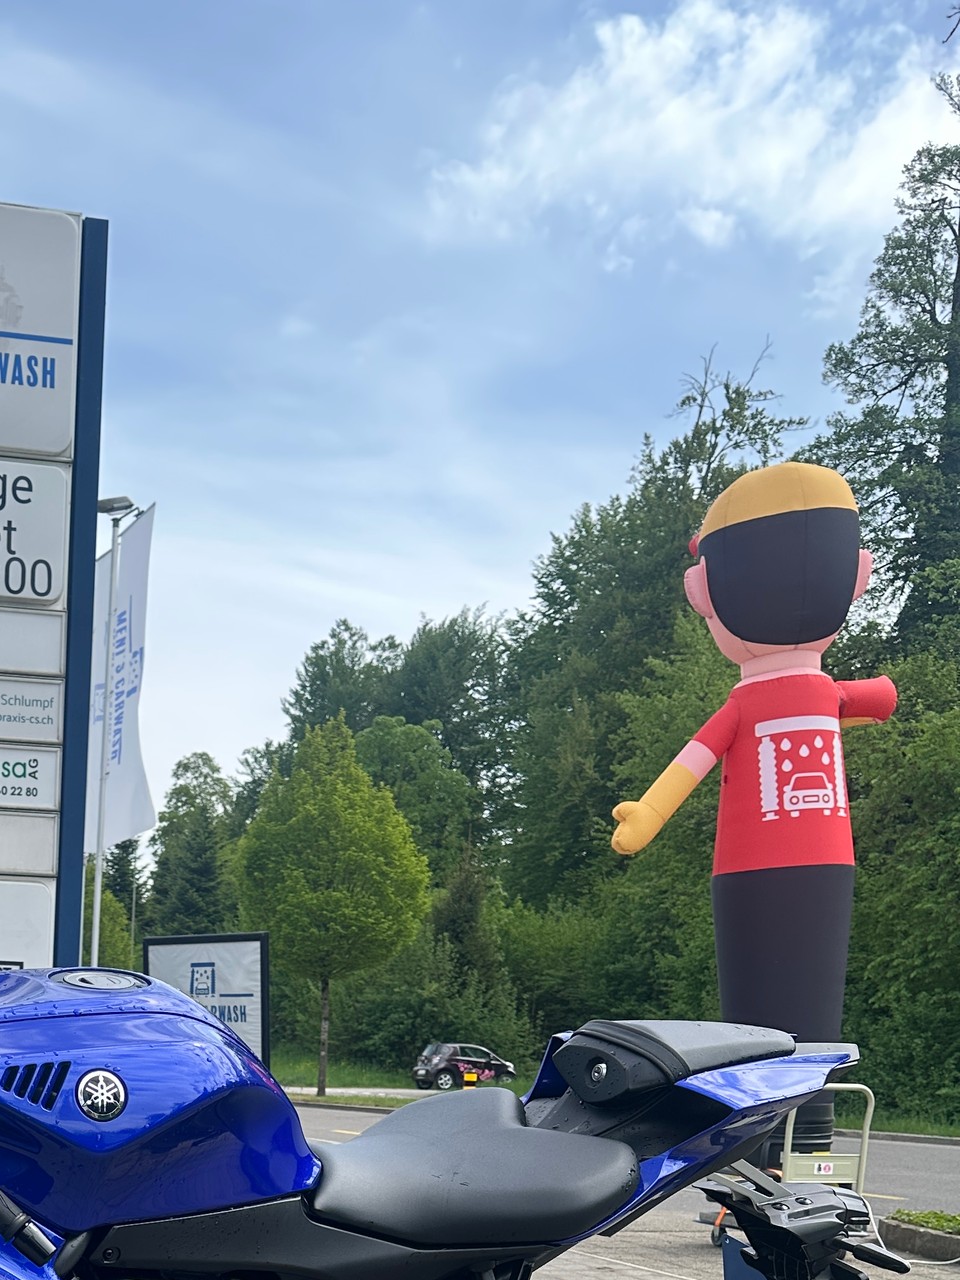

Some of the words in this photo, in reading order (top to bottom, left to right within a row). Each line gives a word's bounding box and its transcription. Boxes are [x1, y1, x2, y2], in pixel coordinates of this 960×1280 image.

[1, 694, 55, 710] Schlumpf
[29, 758, 39, 780] AG
[10, 786, 23, 796] 22
[25, 786, 38, 797] 80
